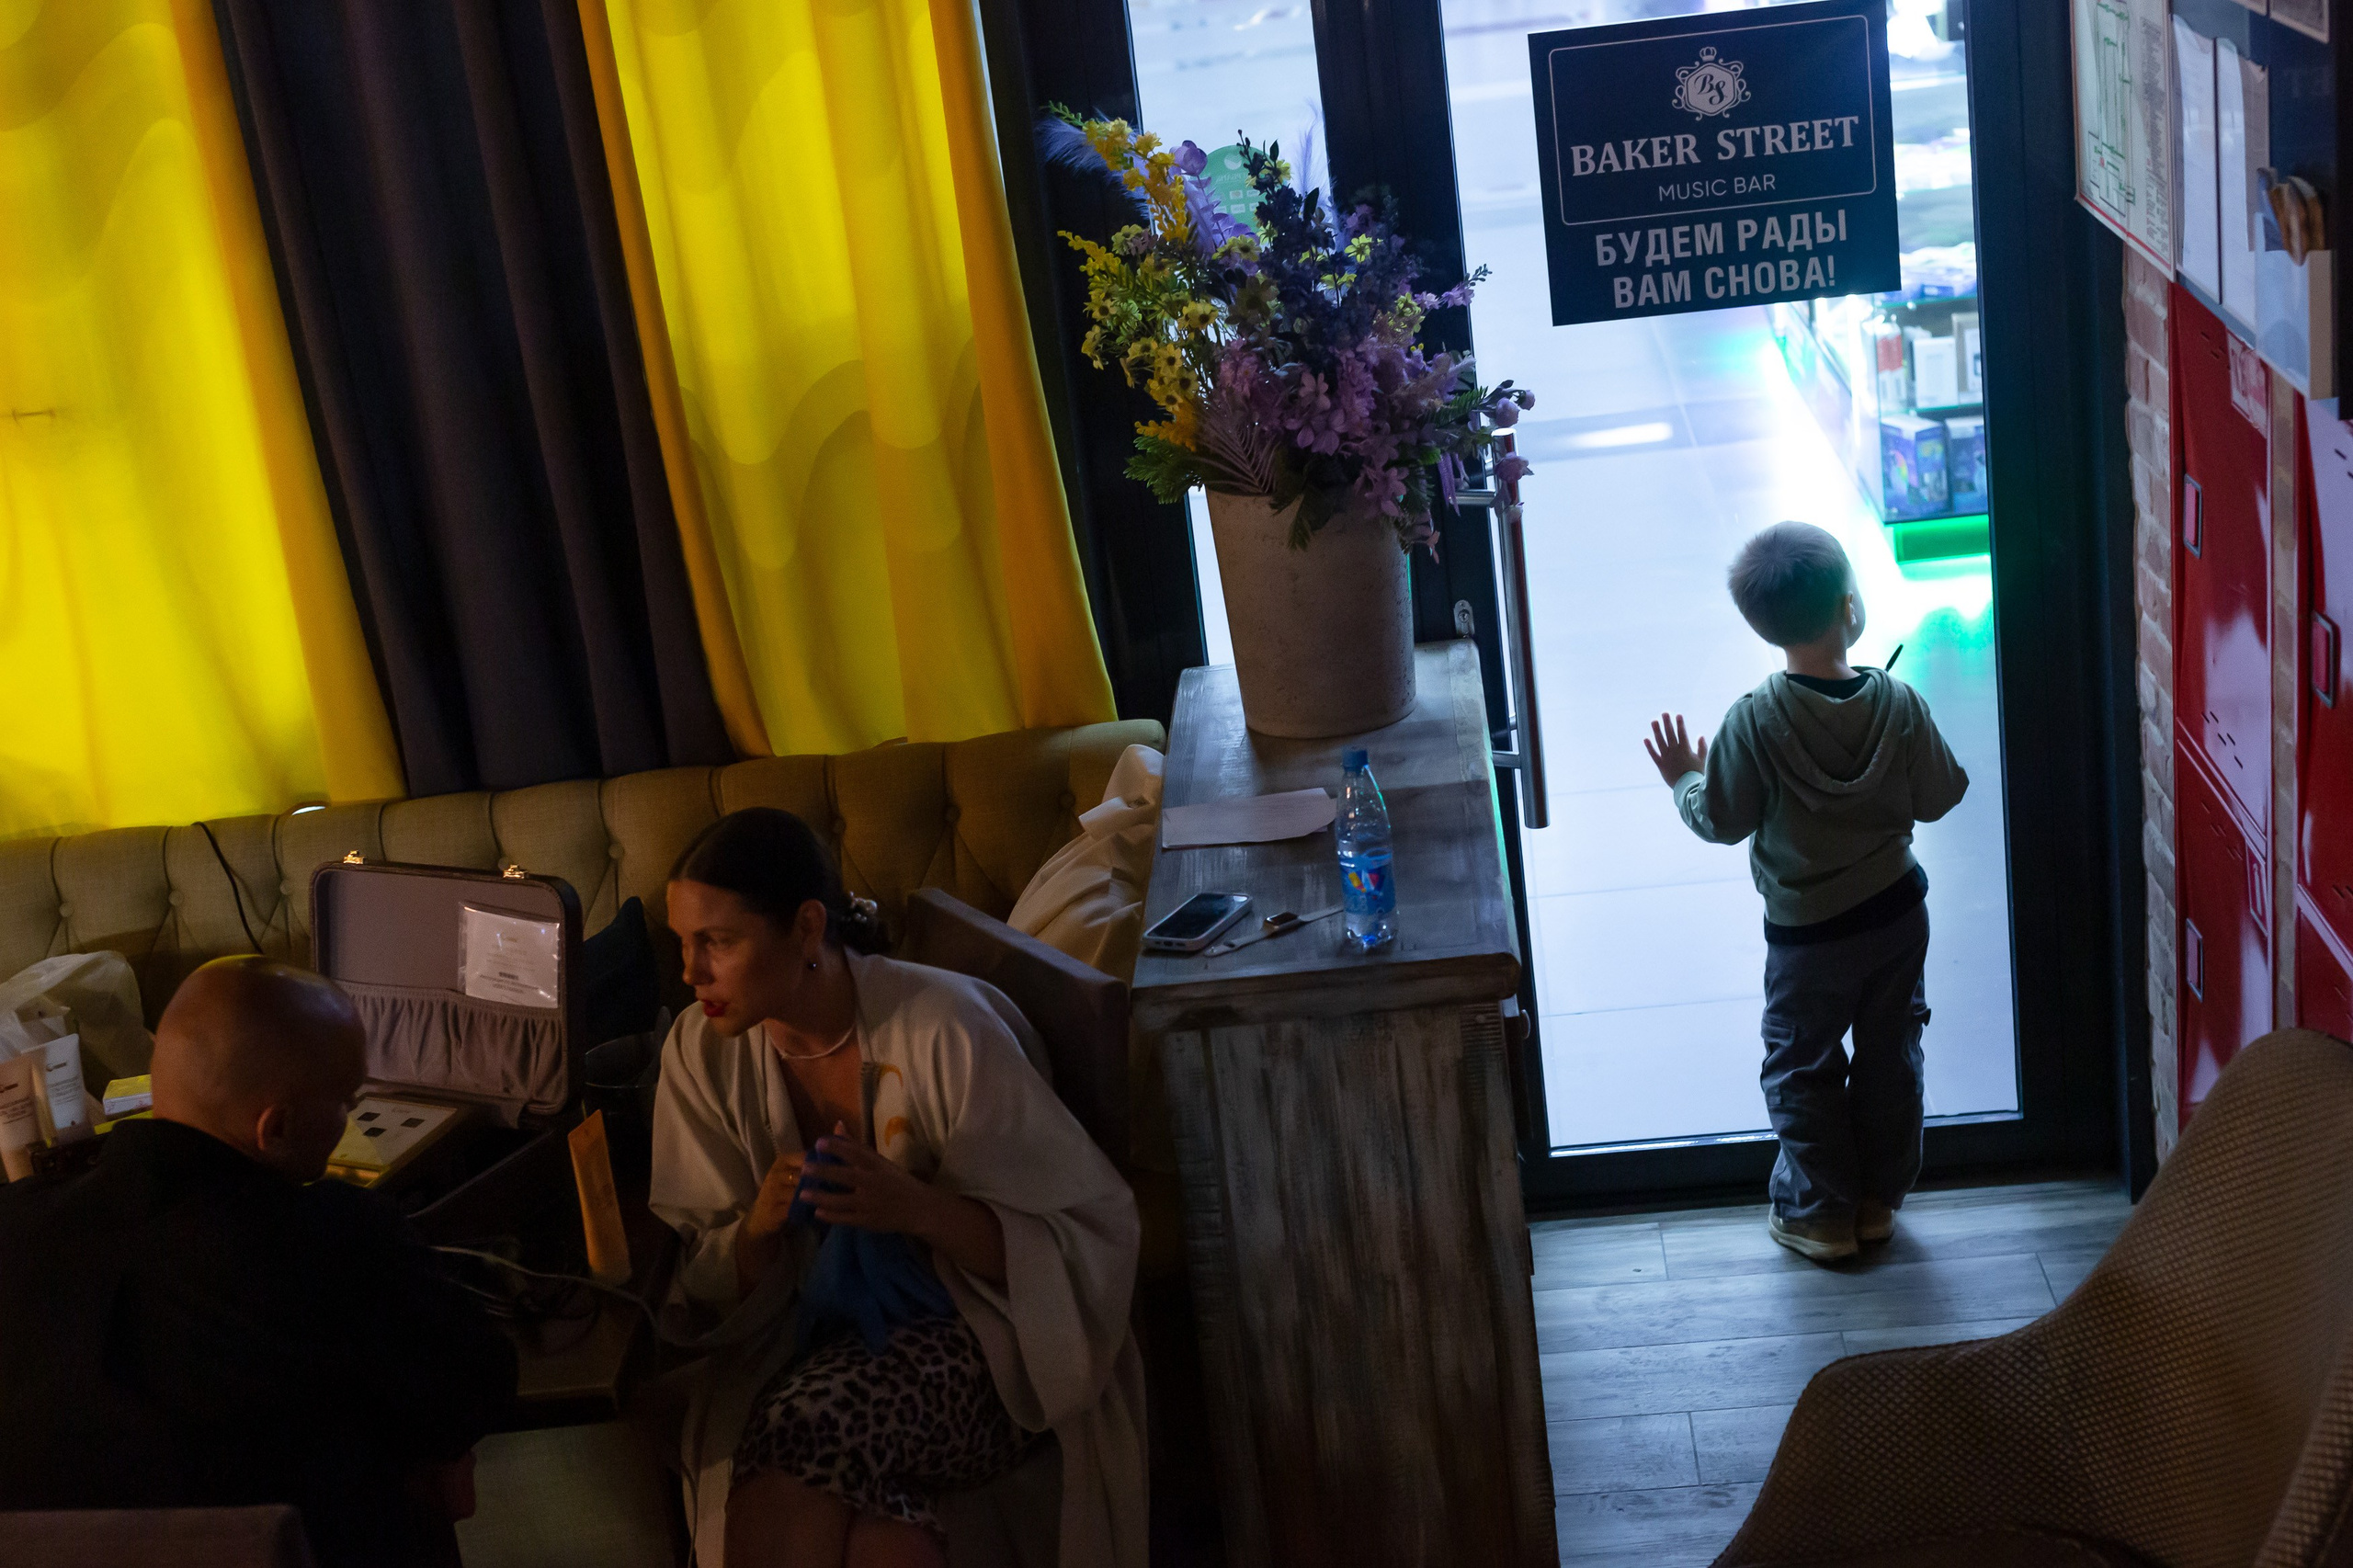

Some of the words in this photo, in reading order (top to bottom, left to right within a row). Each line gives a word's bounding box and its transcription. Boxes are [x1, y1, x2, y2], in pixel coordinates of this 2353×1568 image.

[1570, 133, 1700, 176] BAKER
[1716, 116, 1859, 161] STREET
[1658, 178, 1727, 201] MUSIC
[1734, 174, 1776, 194] BAR
[1596, 222, 1723, 267] БУДЕМ
[1737, 209, 1847, 252] РАДЫ
[1613, 270, 1691, 309] ВАМ
[1704, 256, 1836, 299] СНОВА!
